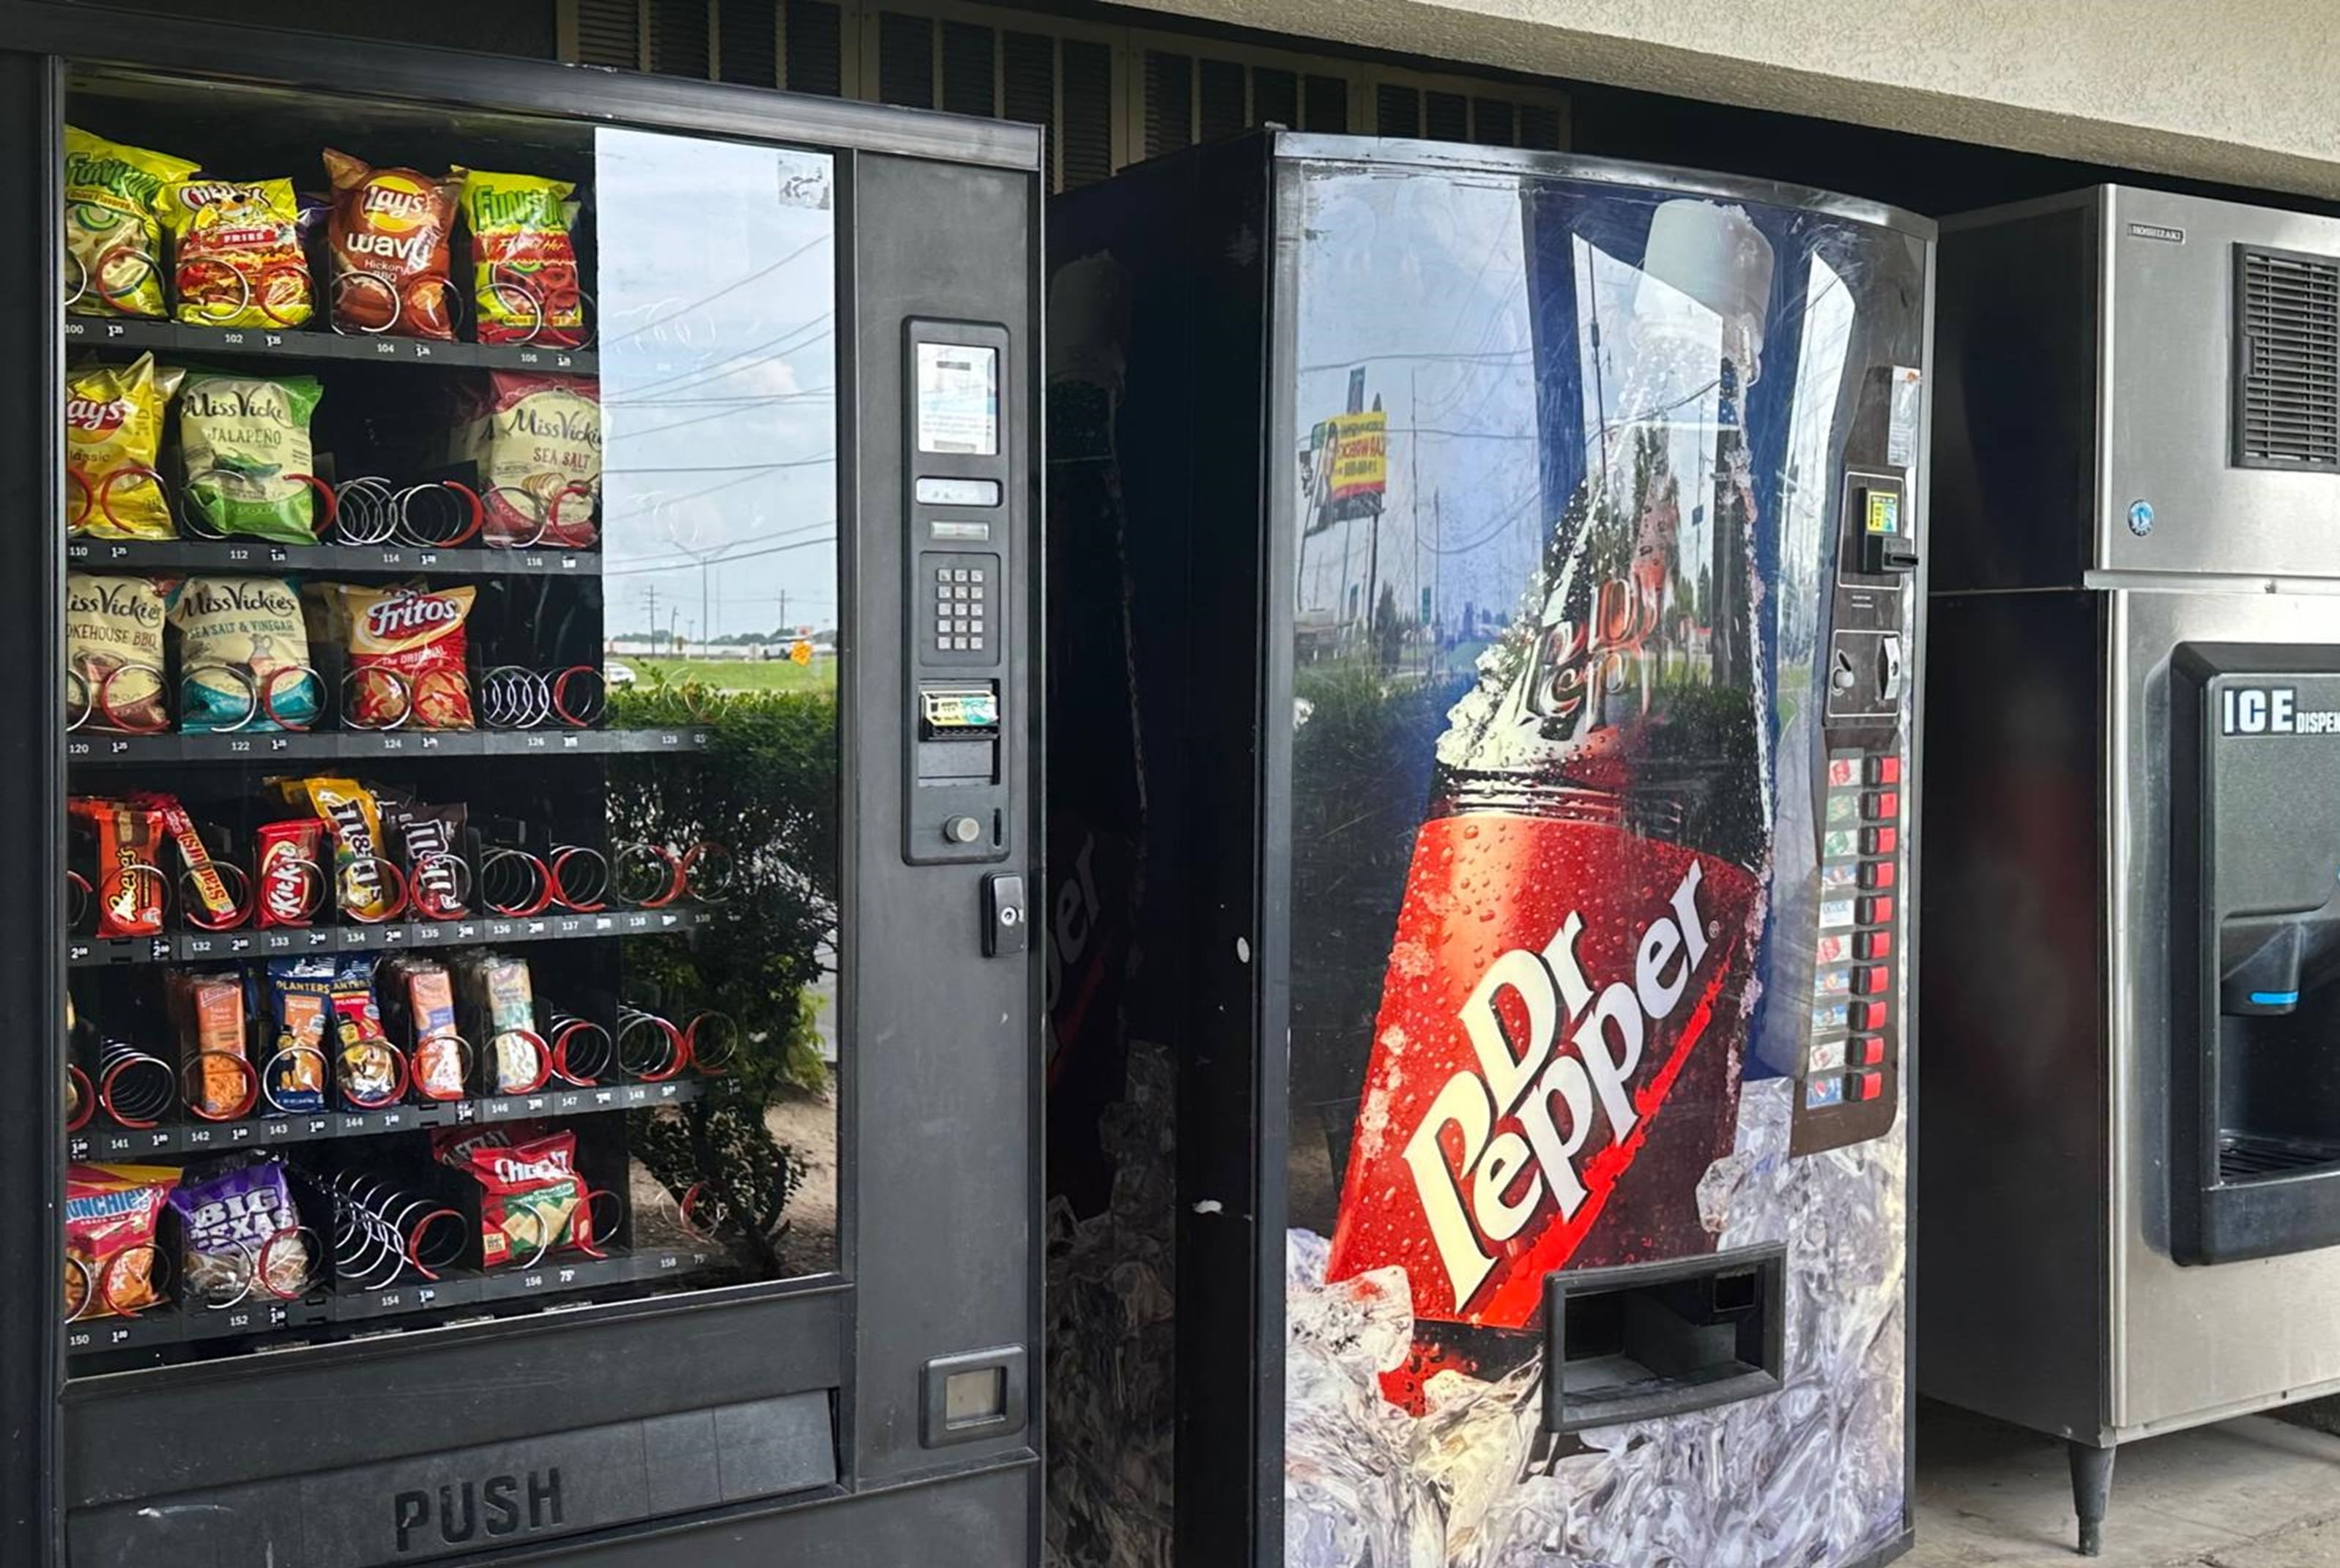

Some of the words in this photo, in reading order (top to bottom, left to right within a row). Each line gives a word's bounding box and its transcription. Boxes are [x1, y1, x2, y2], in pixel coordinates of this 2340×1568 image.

[223, 233, 264, 243] FRIES
[66, 324, 83, 333] 100
[226, 334, 242, 343] 102
[378, 343, 394, 352] 104
[182, 393, 237, 418] Miss
[505, 408, 560, 438] Miss
[208, 427, 282, 445] JALAPEÑO
[533, 447, 557, 464] SEA
[562, 451, 590, 470] SALT
[70, 547, 88, 556] 110
[231, 550, 248, 559] 112
[384, 554, 399, 562] 114
[183, 590, 229, 617] Miss
[367, 597, 456, 636] Fritos
[188, 626, 210, 640] SEA
[211, 622, 238, 636] SALT
[240, 620, 250, 633] &
[250, 619, 295, 633] VINEGAR
[132, 633, 157, 650] BBQ
[2224, 689, 2294, 733] ICE
[232, 742, 250, 751] 122
[385, 740, 401, 748] 124
[528, 737, 544, 746] 126
[70, 744, 89, 753] 120
[494, 925, 510, 934] 136
[562, 921, 579, 930] 137
[348, 933, 365, 942] 134
[422, 929, 439, 938] 135
[193, 942, 210, 951] 132
[271, 937, 289, 946] 133
[276, 981, 330, 995] PLANTERS
[1457, 910, 1594, 1109] Dr
[1402, 859, 1709, 1314] Pepper
[562, 1097, 577, 1107] 147
[492, 1104, 508, 1113] 146
[346, 1118, 363, 1127] 144
[270, 1124, 287, 1134] 143
[192, 1132, 209, 1141] 142
[112, 1139, 128, 1148] 141
[192, 1186, 279, 1229] BIG
[188, 1208, 294, 1243] TEXAS
[526, 1276, 541, 1286] 156
[382, 1296, 398, 1306] 154
[231, 1315, 248, 1326] 152
[70, 1334, 89, 1345] 150
[394, 1466, 563, 1552] PUSH
